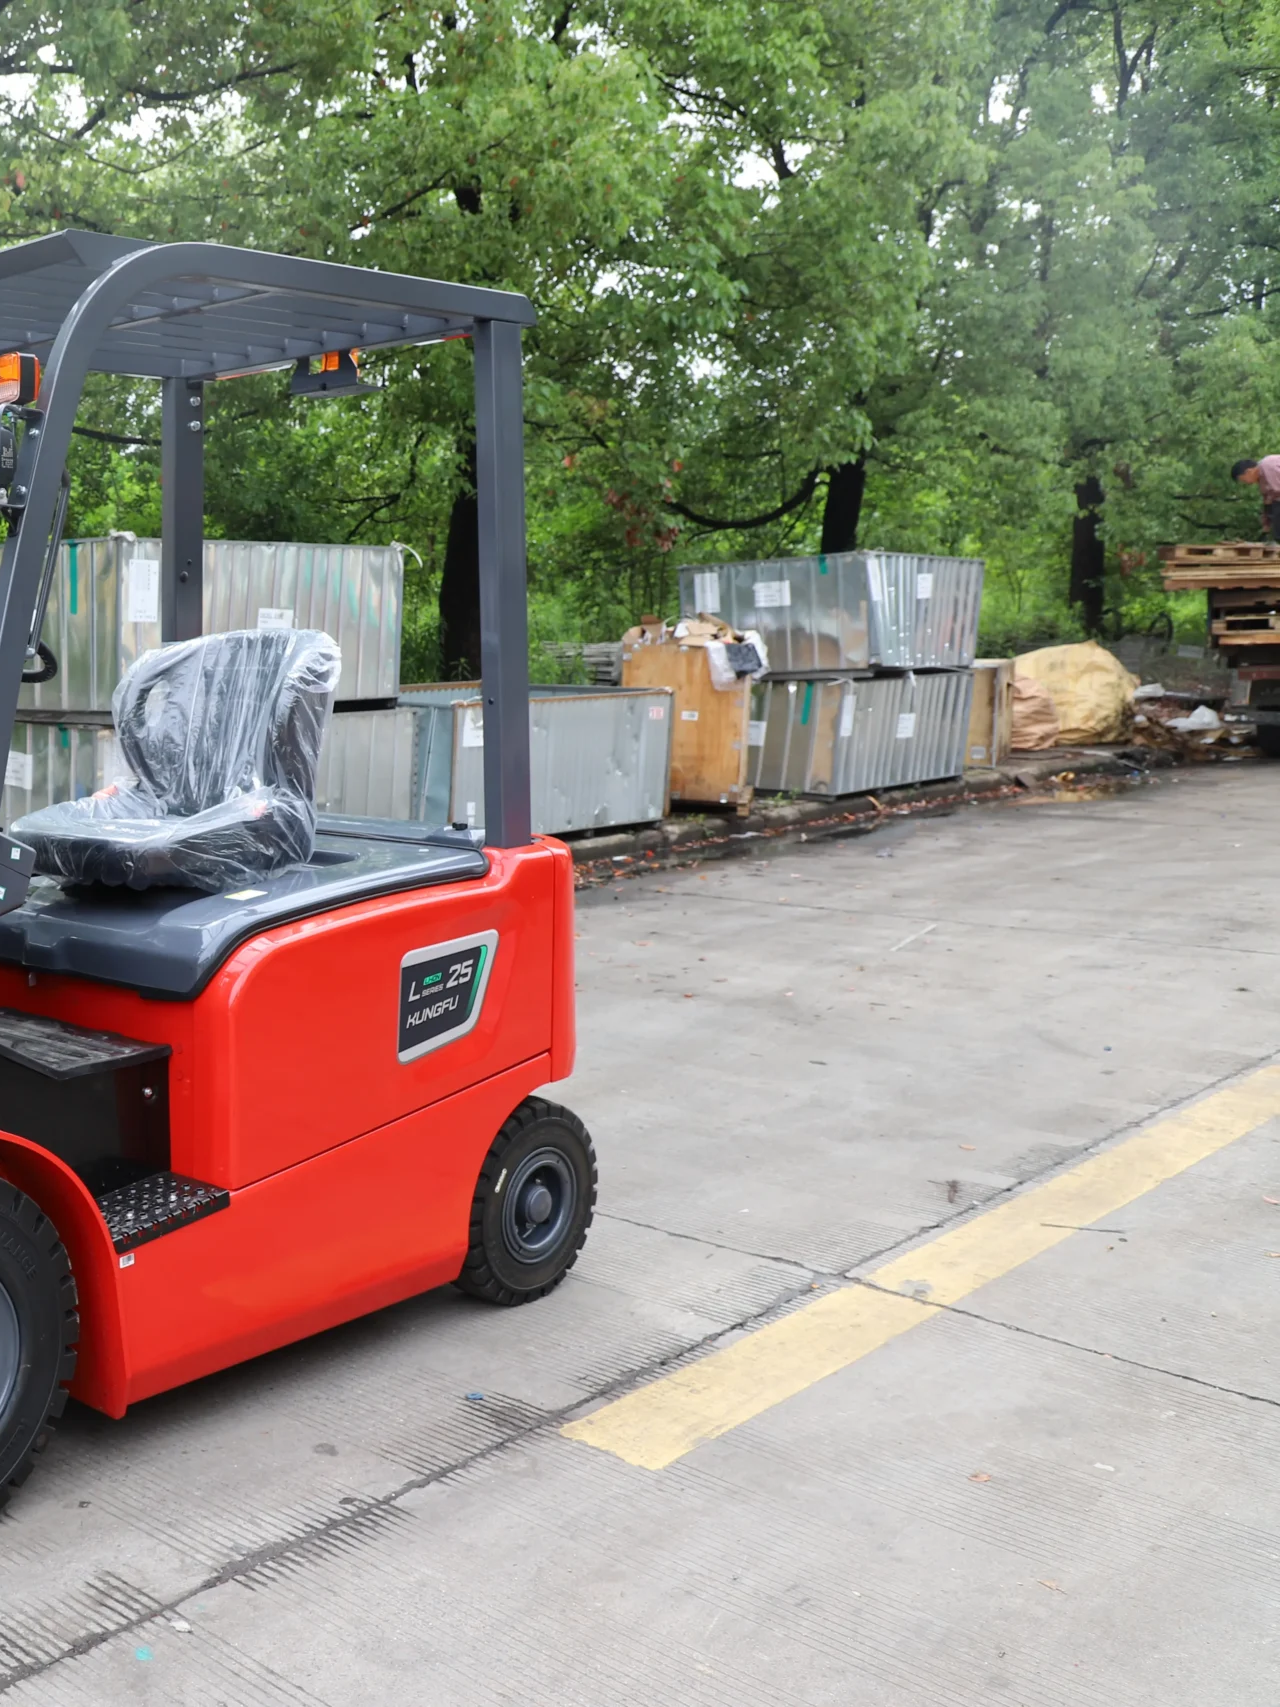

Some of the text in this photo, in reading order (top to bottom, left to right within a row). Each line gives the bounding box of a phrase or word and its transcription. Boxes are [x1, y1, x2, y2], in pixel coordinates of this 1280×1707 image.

[408, 959, 474, 1002] L SERIES 25
[406, 995, 460, 1029] KUNGFU
